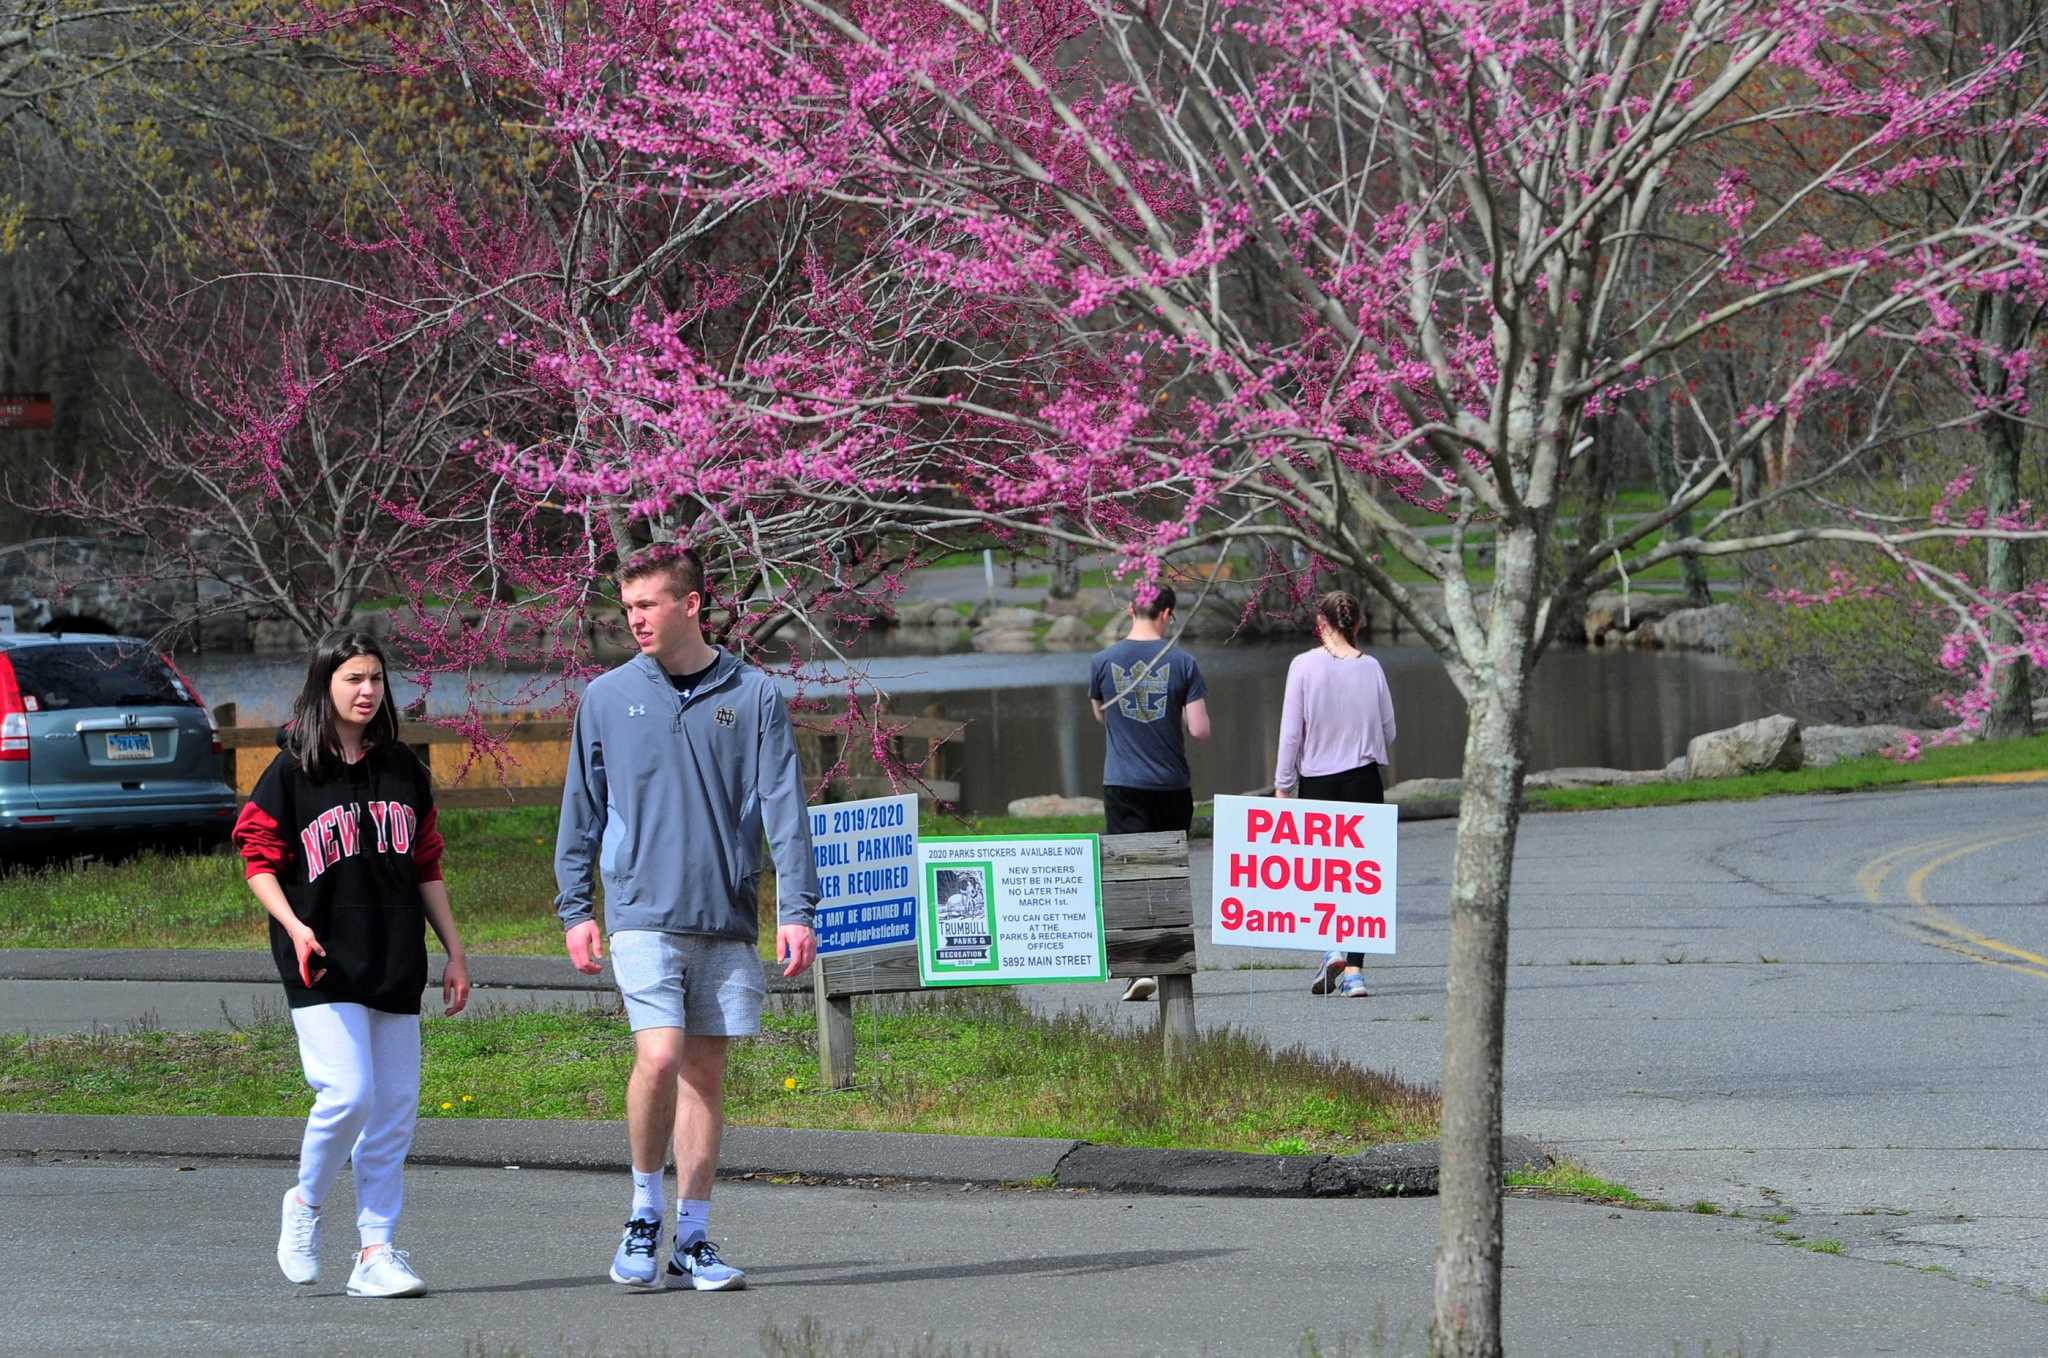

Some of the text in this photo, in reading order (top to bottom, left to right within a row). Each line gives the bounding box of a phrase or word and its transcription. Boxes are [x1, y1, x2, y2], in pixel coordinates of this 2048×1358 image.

[834, 804, 904, 833] 2019/2020
[1247, 809, 1365, 848] PARK
[301, 802, 360, 883] NEW
[857, 834, 913, 862] PARKING
[928, 846, 1084, 859] 2020 PARKS STICKERS AVAILABLE NOW
[1008, 866, 1076, 875] NEW STICKERS
[1230, 853, 1382, 895] HOURS
[848, 866, 908, 896] REQUIRED
[1001, 876, 1084, 886] MUST BE IN PLACE
[1008, 888, 1078, 897] NO LATER THAN
[1019, 899, 1050, 907] MARCH
[826, 911, 844, 927] MAY
[848, 909, 858, 924] BE
[861, 903, 899, 922] OBTAINED
[903, 901, 912, 916] AT
[1002, 913, 1087, 922] YOU CAN GET THEM
[1220, 897, 1386, 943] 9am-7pm
[939, 921, 987, 936] TRUMBULL
[1029, 923, 1060, 932] AT THE
[953, 937, 977, 945] PARKS
[1000, 931, 1093, 941] PARKS & RECREATION
[1027, 942, 1065, 951] OFFICES
[939, 950, 983, 959] RECREATION
[1003, 955, 1093, 968] 5892 MAIN STREET
